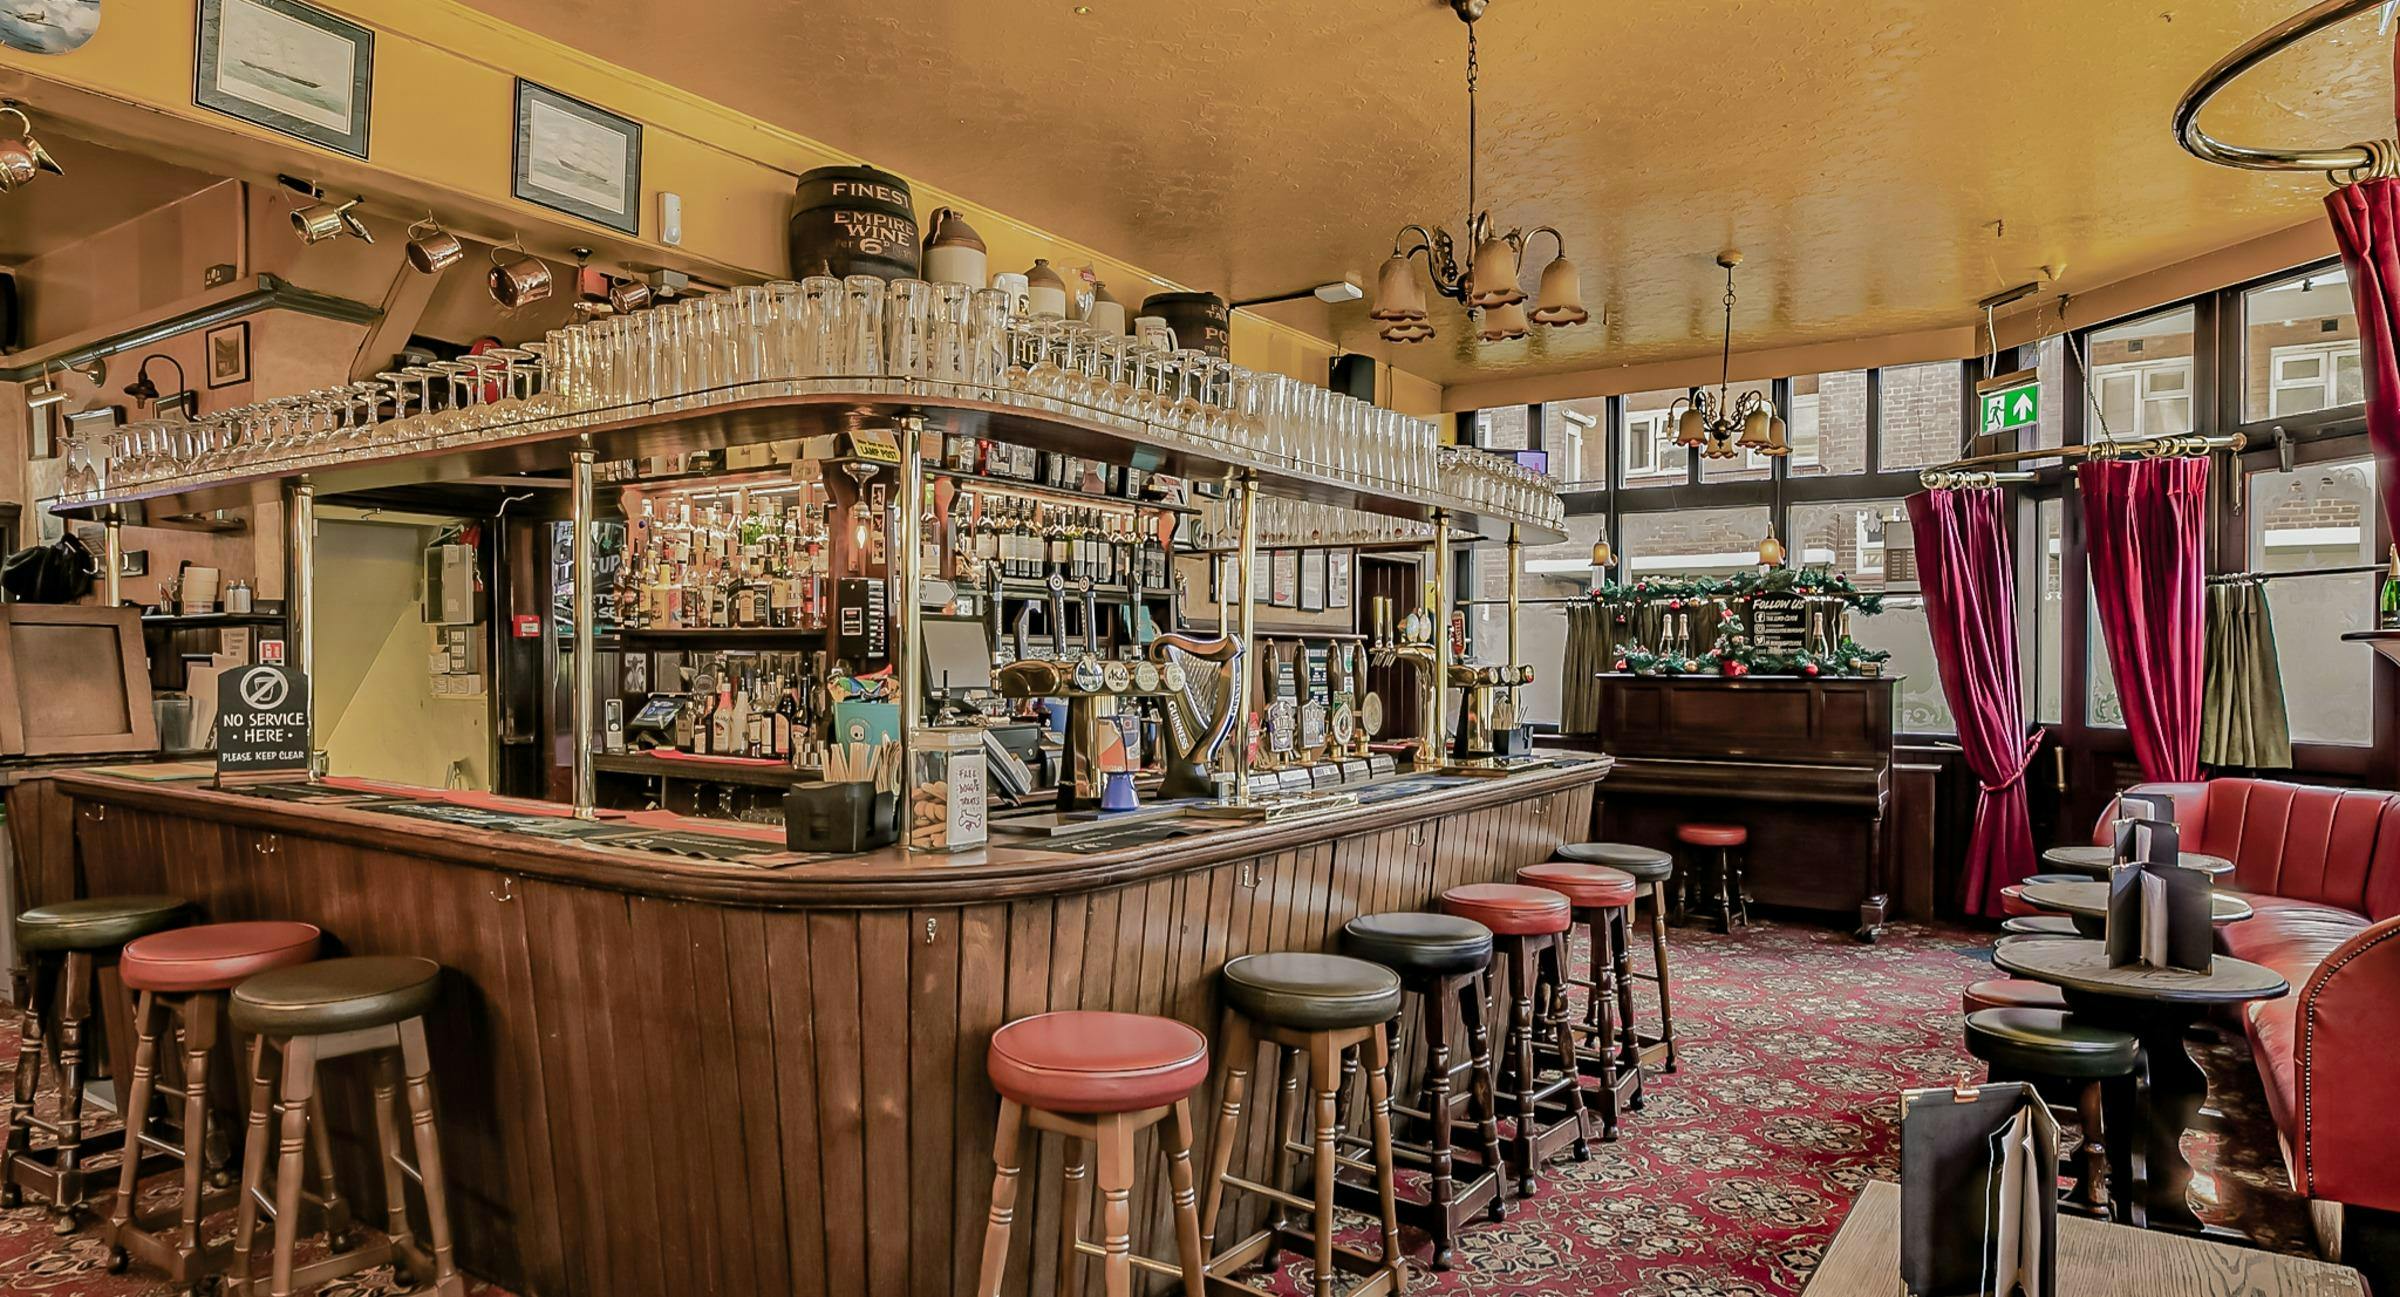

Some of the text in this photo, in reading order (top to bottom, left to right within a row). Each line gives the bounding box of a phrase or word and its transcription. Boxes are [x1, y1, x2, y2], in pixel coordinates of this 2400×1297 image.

[833, 210, 914, 237] EMPIRE
[846, 224, 910, 247] WINE
[223, 712, 305, 727] NO SERVICE
[1168, 700, 1189, 750] GUINNESS
[244, 728, 284, 743] HERE
[222, 750, 304, 762] PLEASE KEEP CLEAR
